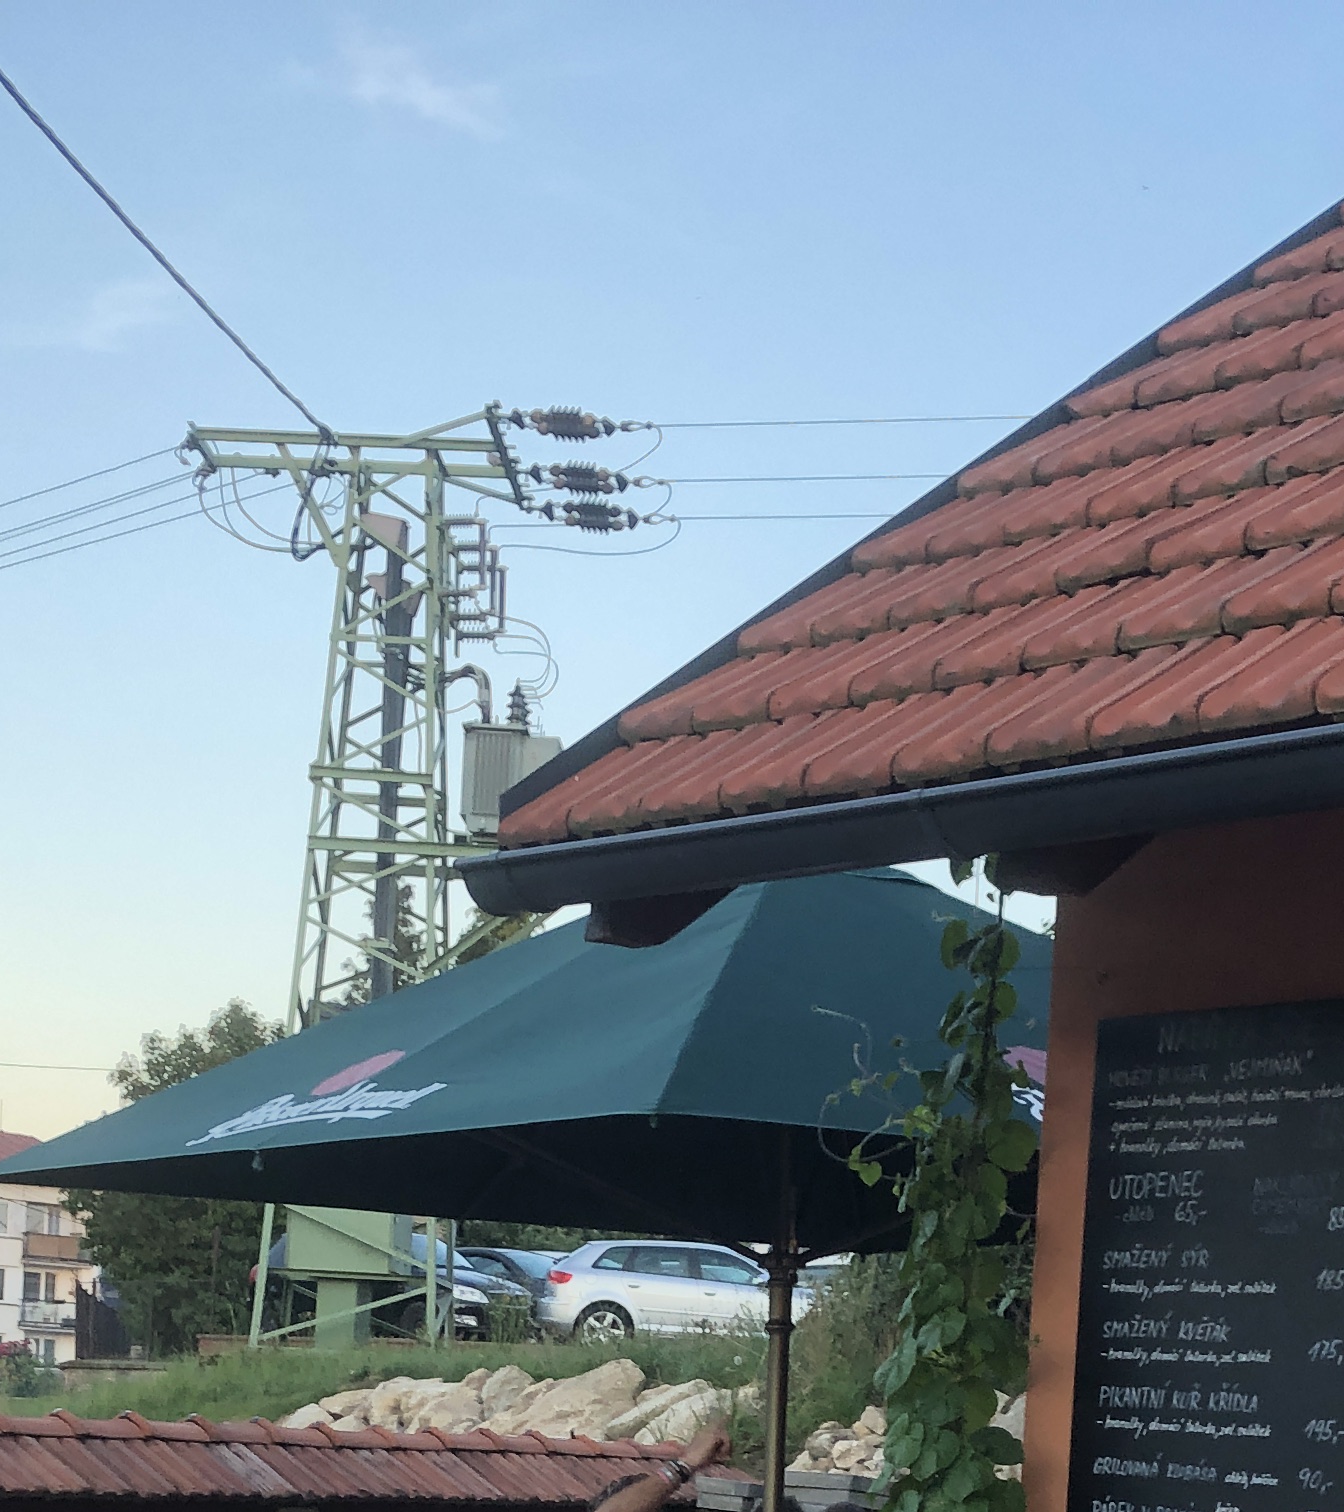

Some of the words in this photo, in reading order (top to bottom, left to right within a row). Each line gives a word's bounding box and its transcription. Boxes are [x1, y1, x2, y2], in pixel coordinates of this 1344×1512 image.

[1109, 1169, 1205, 1200] UTOPENEC
[1174, 1201, 1209, 1226] 65,-
[1102, 1242, 1174, 1270] SMAŽENÝ
[1102, 1309, 1174, 1340] SMAŽENÝ
[1098, 1379, 1171, 1409] PIKANTNÍ
